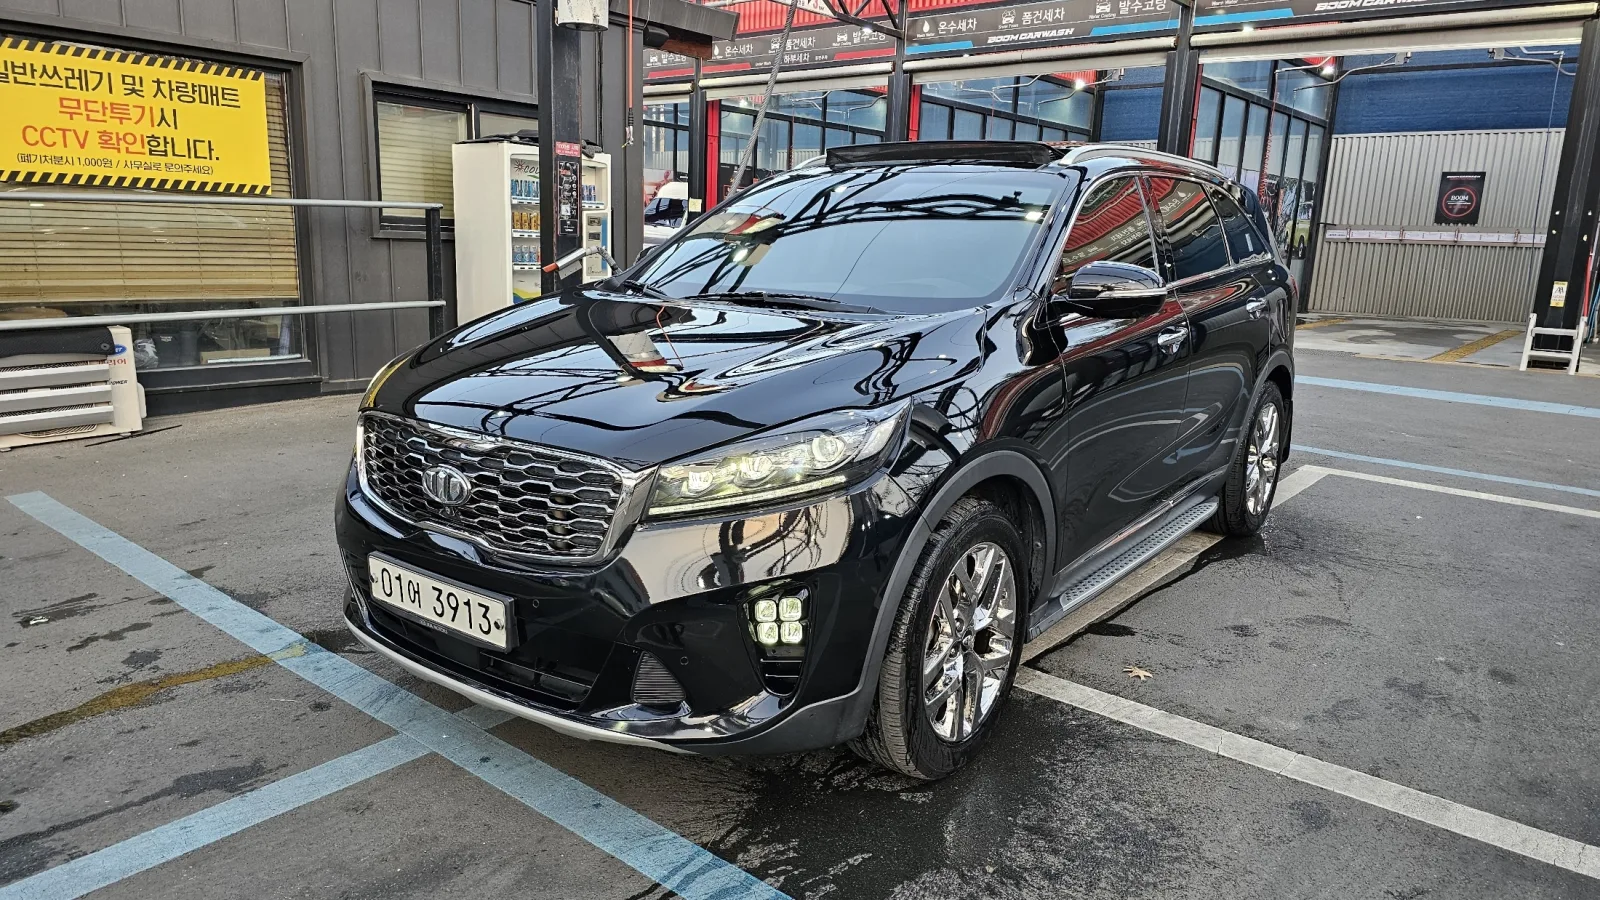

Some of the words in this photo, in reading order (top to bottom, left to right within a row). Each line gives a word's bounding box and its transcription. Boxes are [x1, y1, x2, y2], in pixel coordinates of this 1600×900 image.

[1021, 7, 1065, 25] 폼건세차
[937, 18, 978, 34] 온수세차
[987, 33, 1020, 43] BOOM
[1019, 27, 1075, 40] CARWASH
[724, 43, 754, 57] 온수세차
[121, 74, 145, 98] 및
[152, 78, 241, 108] 차량매트
[59, 97, 178, 130] 무단투기시
[22, 125, 89, 149] CCTV
[97, 130, 220, 161] 확인합니다.
[123, 160, 163, 172] 사무실로
[381, 567, 422, 609] 01어
[431, 586, 491, 635] 3913
